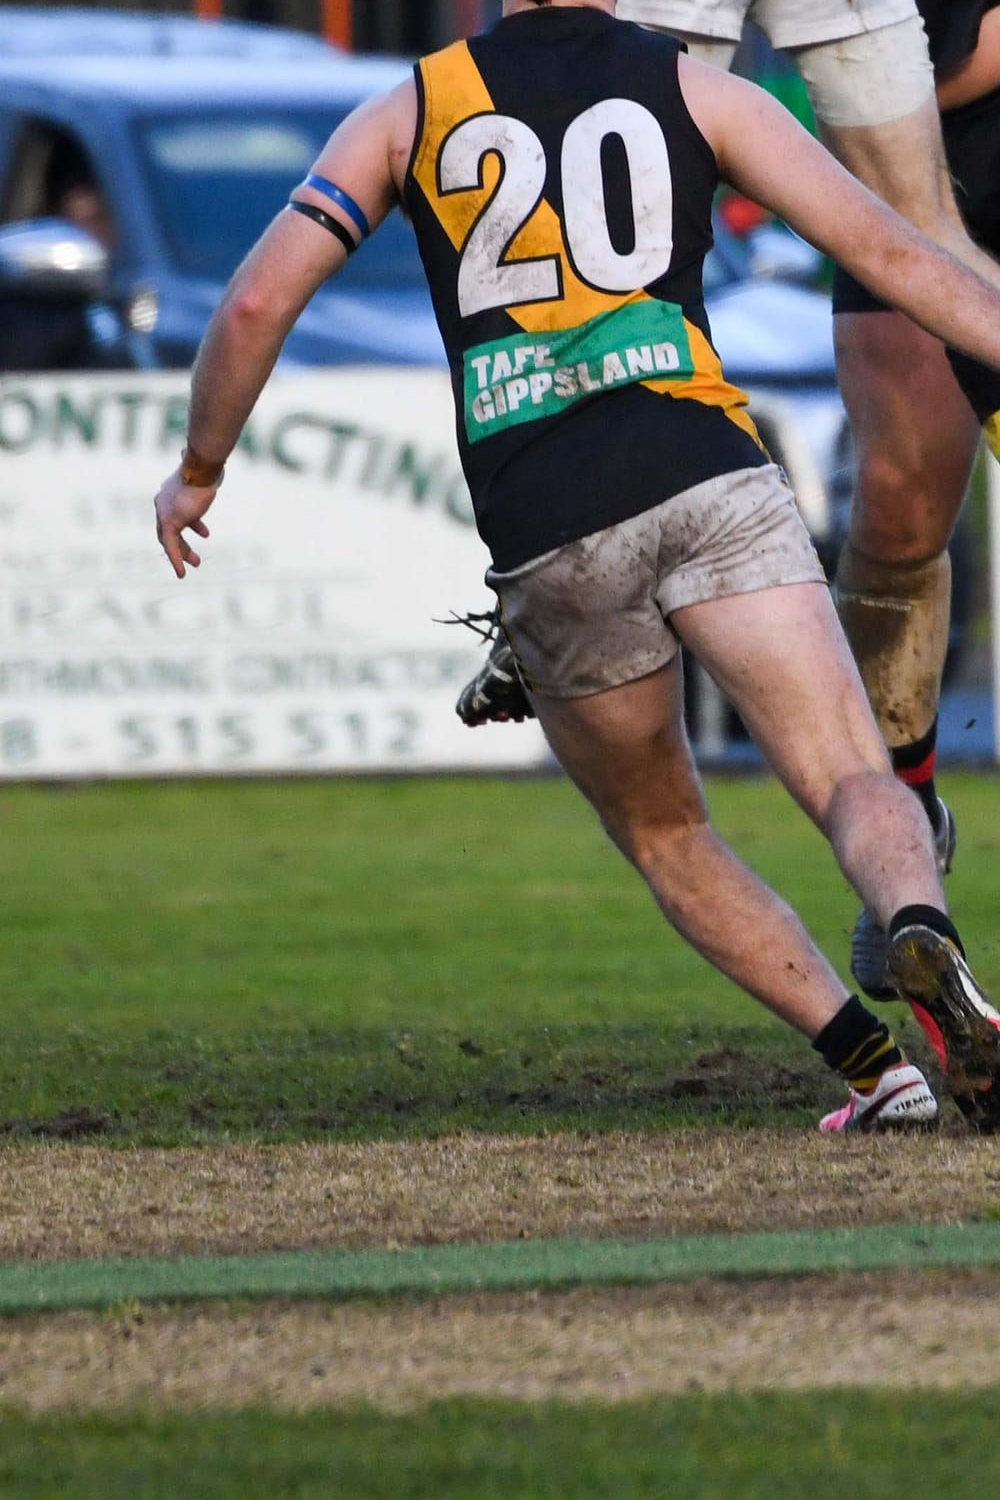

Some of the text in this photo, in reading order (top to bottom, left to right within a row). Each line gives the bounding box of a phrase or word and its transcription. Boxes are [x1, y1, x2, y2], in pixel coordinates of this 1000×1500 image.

[438, 97, 674, 320] 20
[471, 344, 555, 389] TAFE
[471, 341, 681, 424] GIPPSLAND
